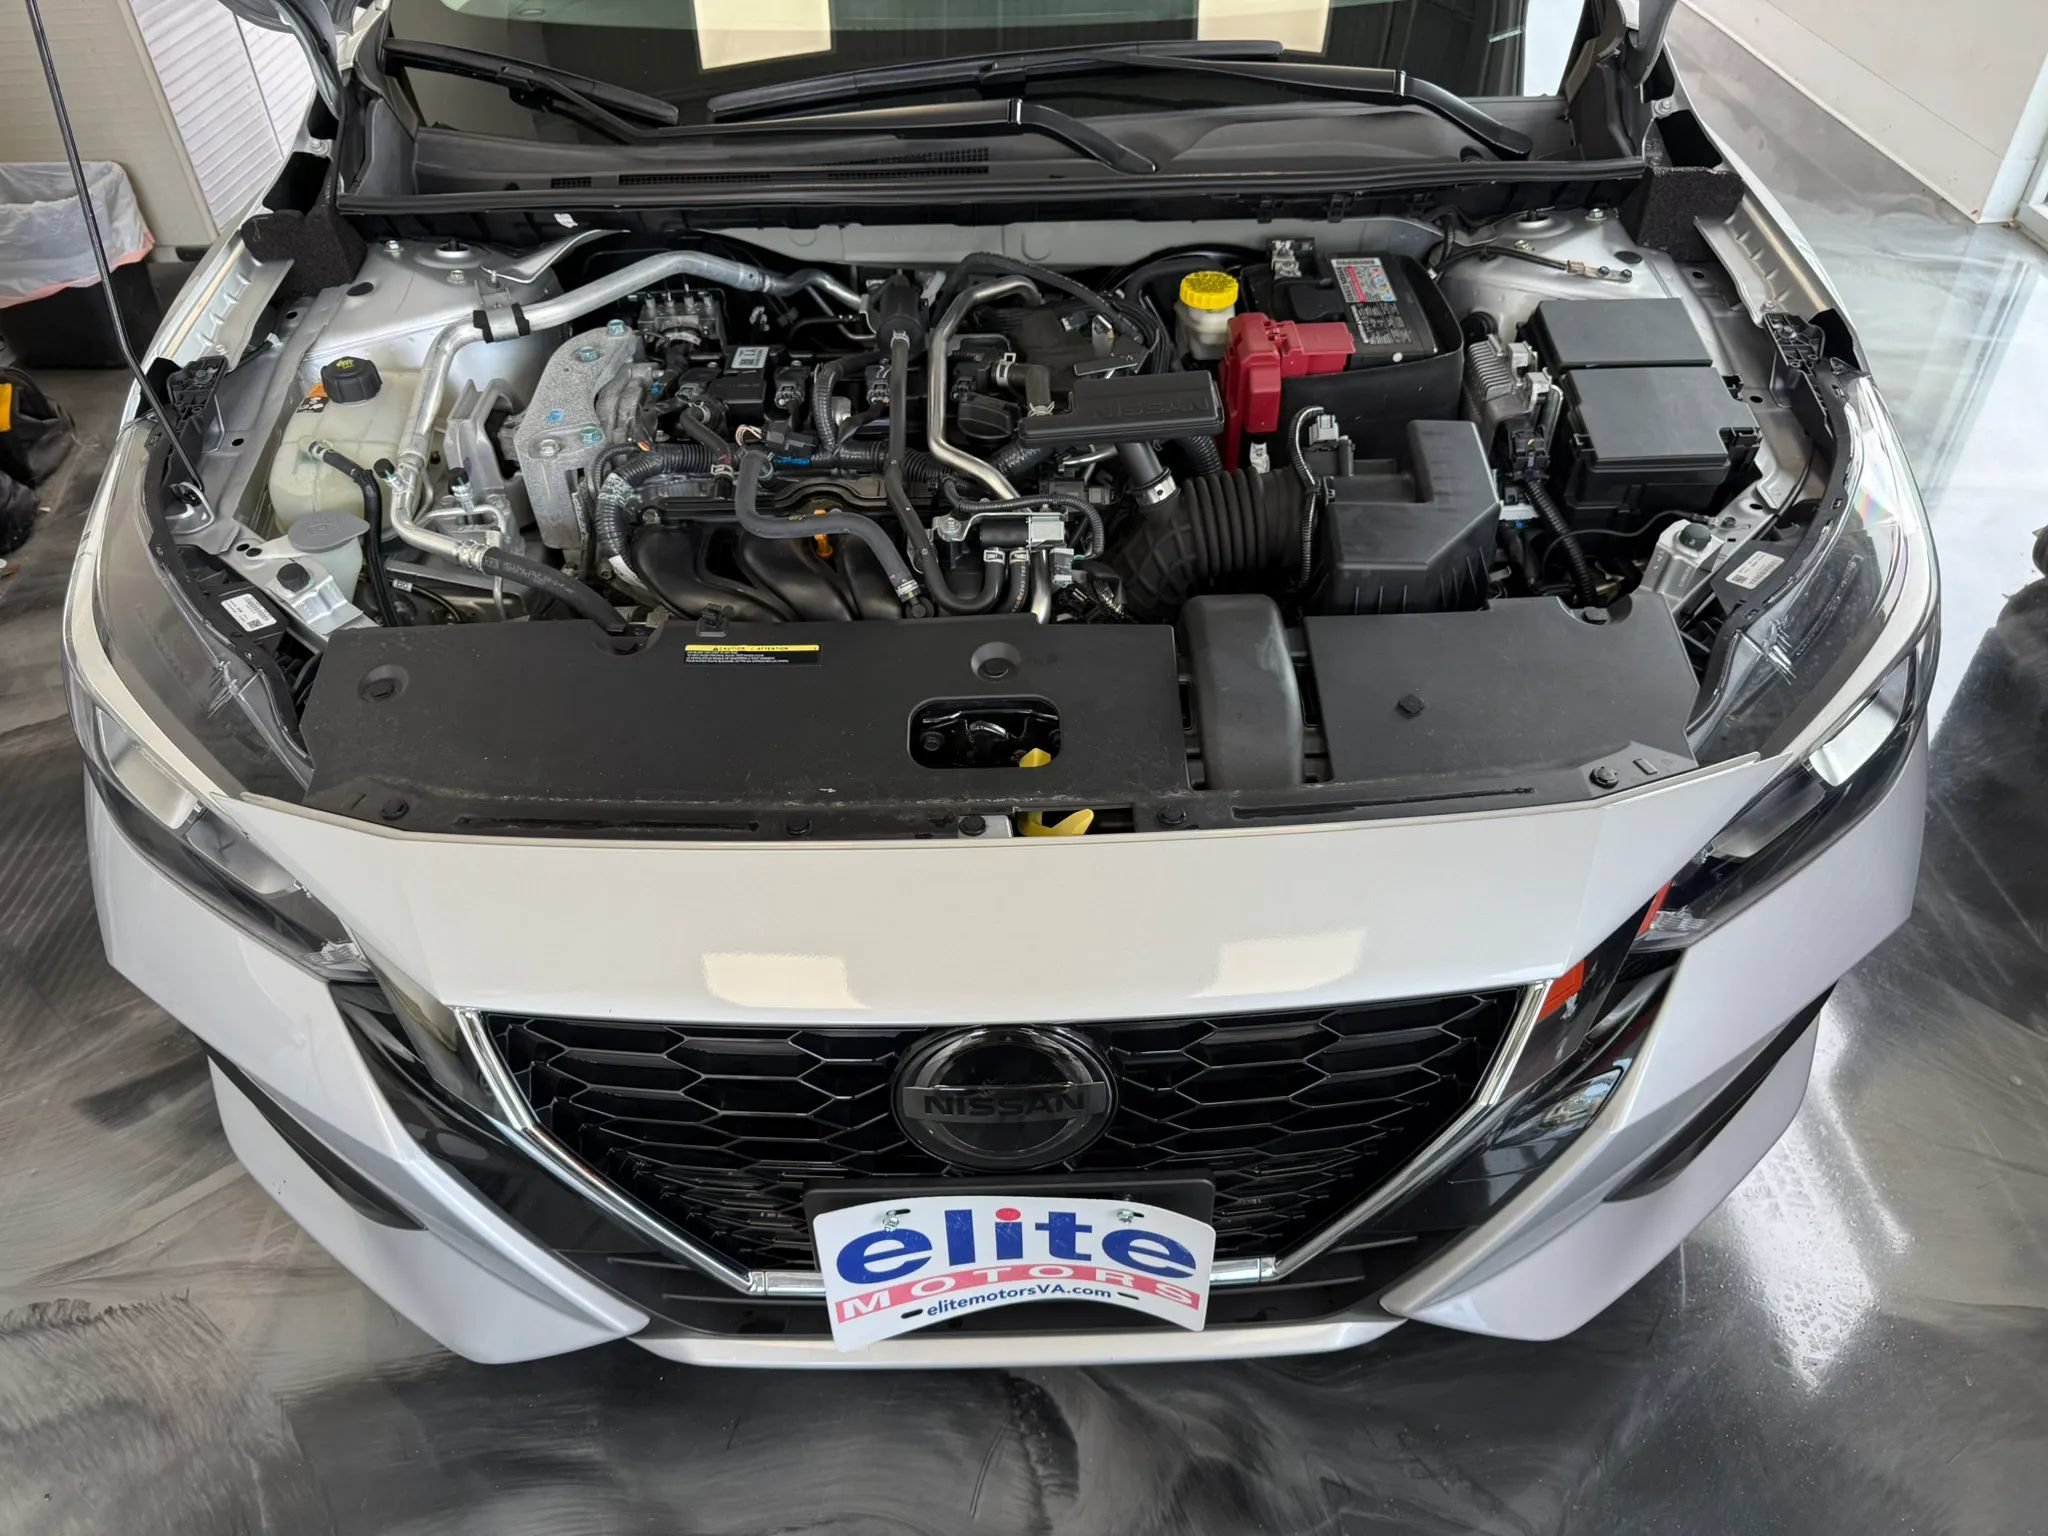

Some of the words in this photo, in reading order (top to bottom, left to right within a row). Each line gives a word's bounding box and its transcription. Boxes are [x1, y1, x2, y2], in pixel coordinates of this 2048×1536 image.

[924, 1091, 1085, 1117] NISSAN
[836, 1207, 1197, 1285] elite
[842, 1264, 1194, 1320] MOTORS
[926, 1283, 1113, 1318] elitemotorsVA.com
